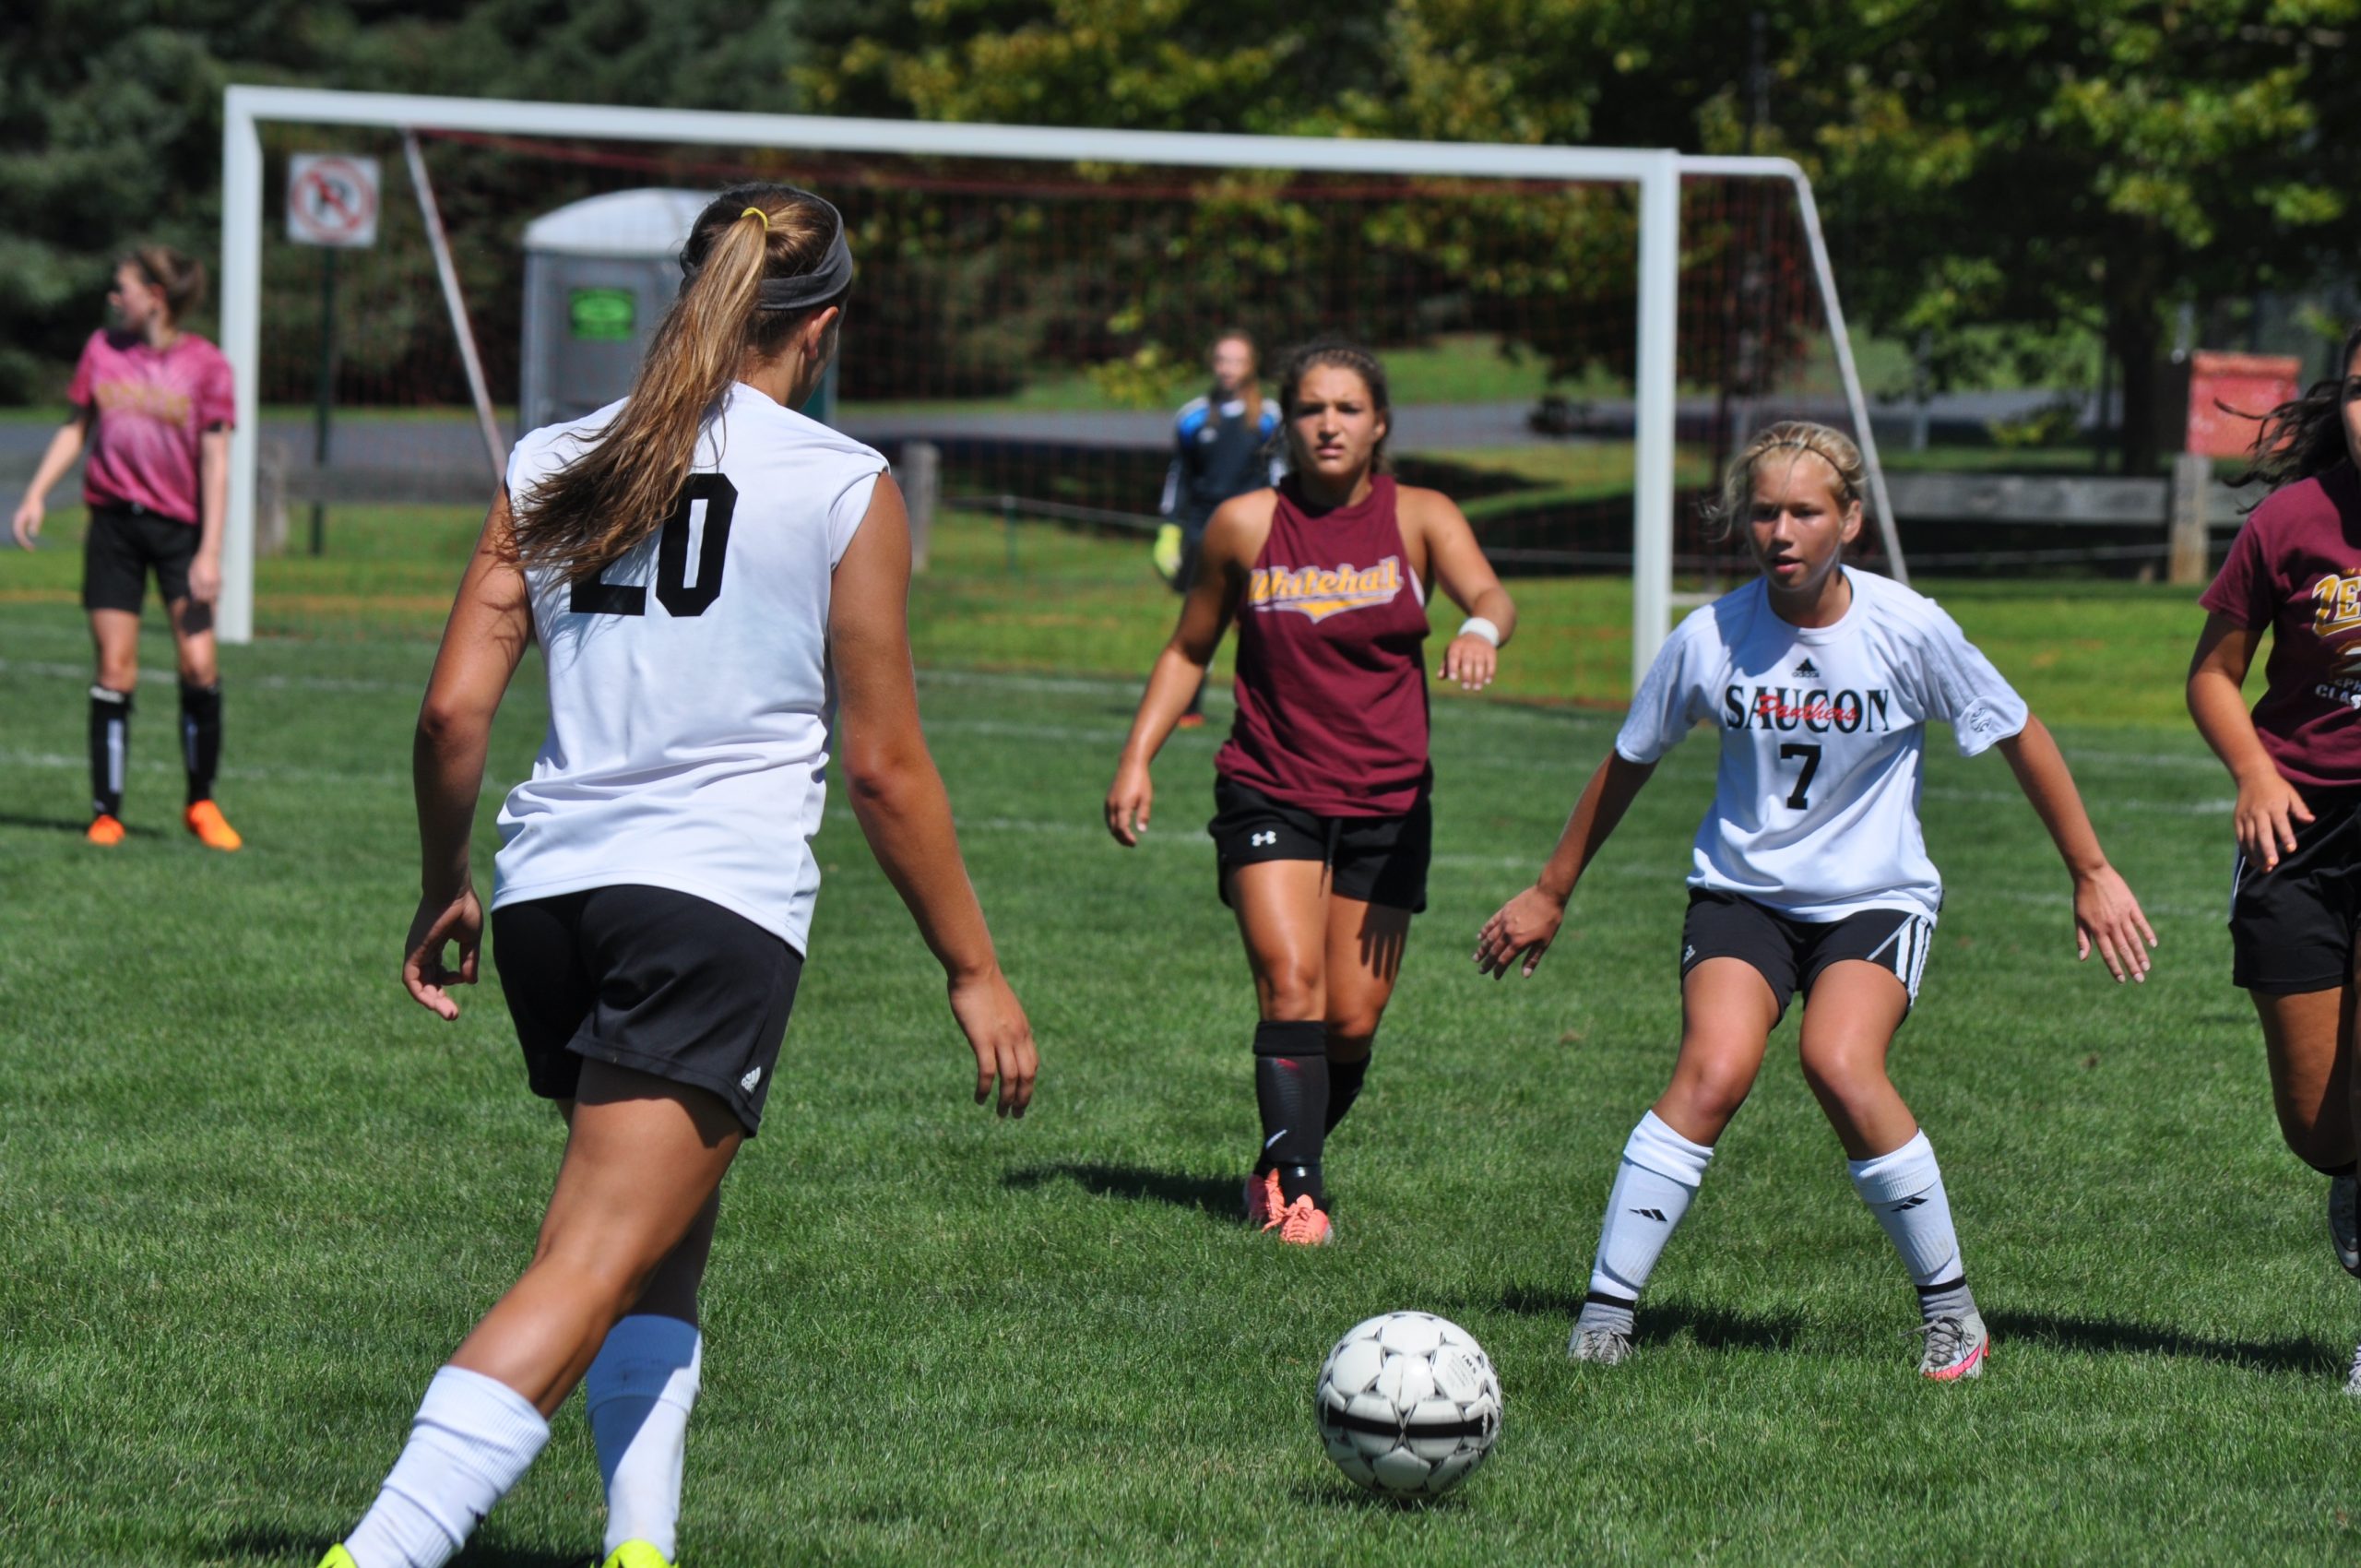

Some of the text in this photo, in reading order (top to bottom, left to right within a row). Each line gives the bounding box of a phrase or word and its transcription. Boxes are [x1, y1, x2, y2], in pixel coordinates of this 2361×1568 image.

[1725, 683, 1890, 734] SAUCON
[1756, 695, 1859, 721] Panthers
[1780, 743, 1822, 811] 7
